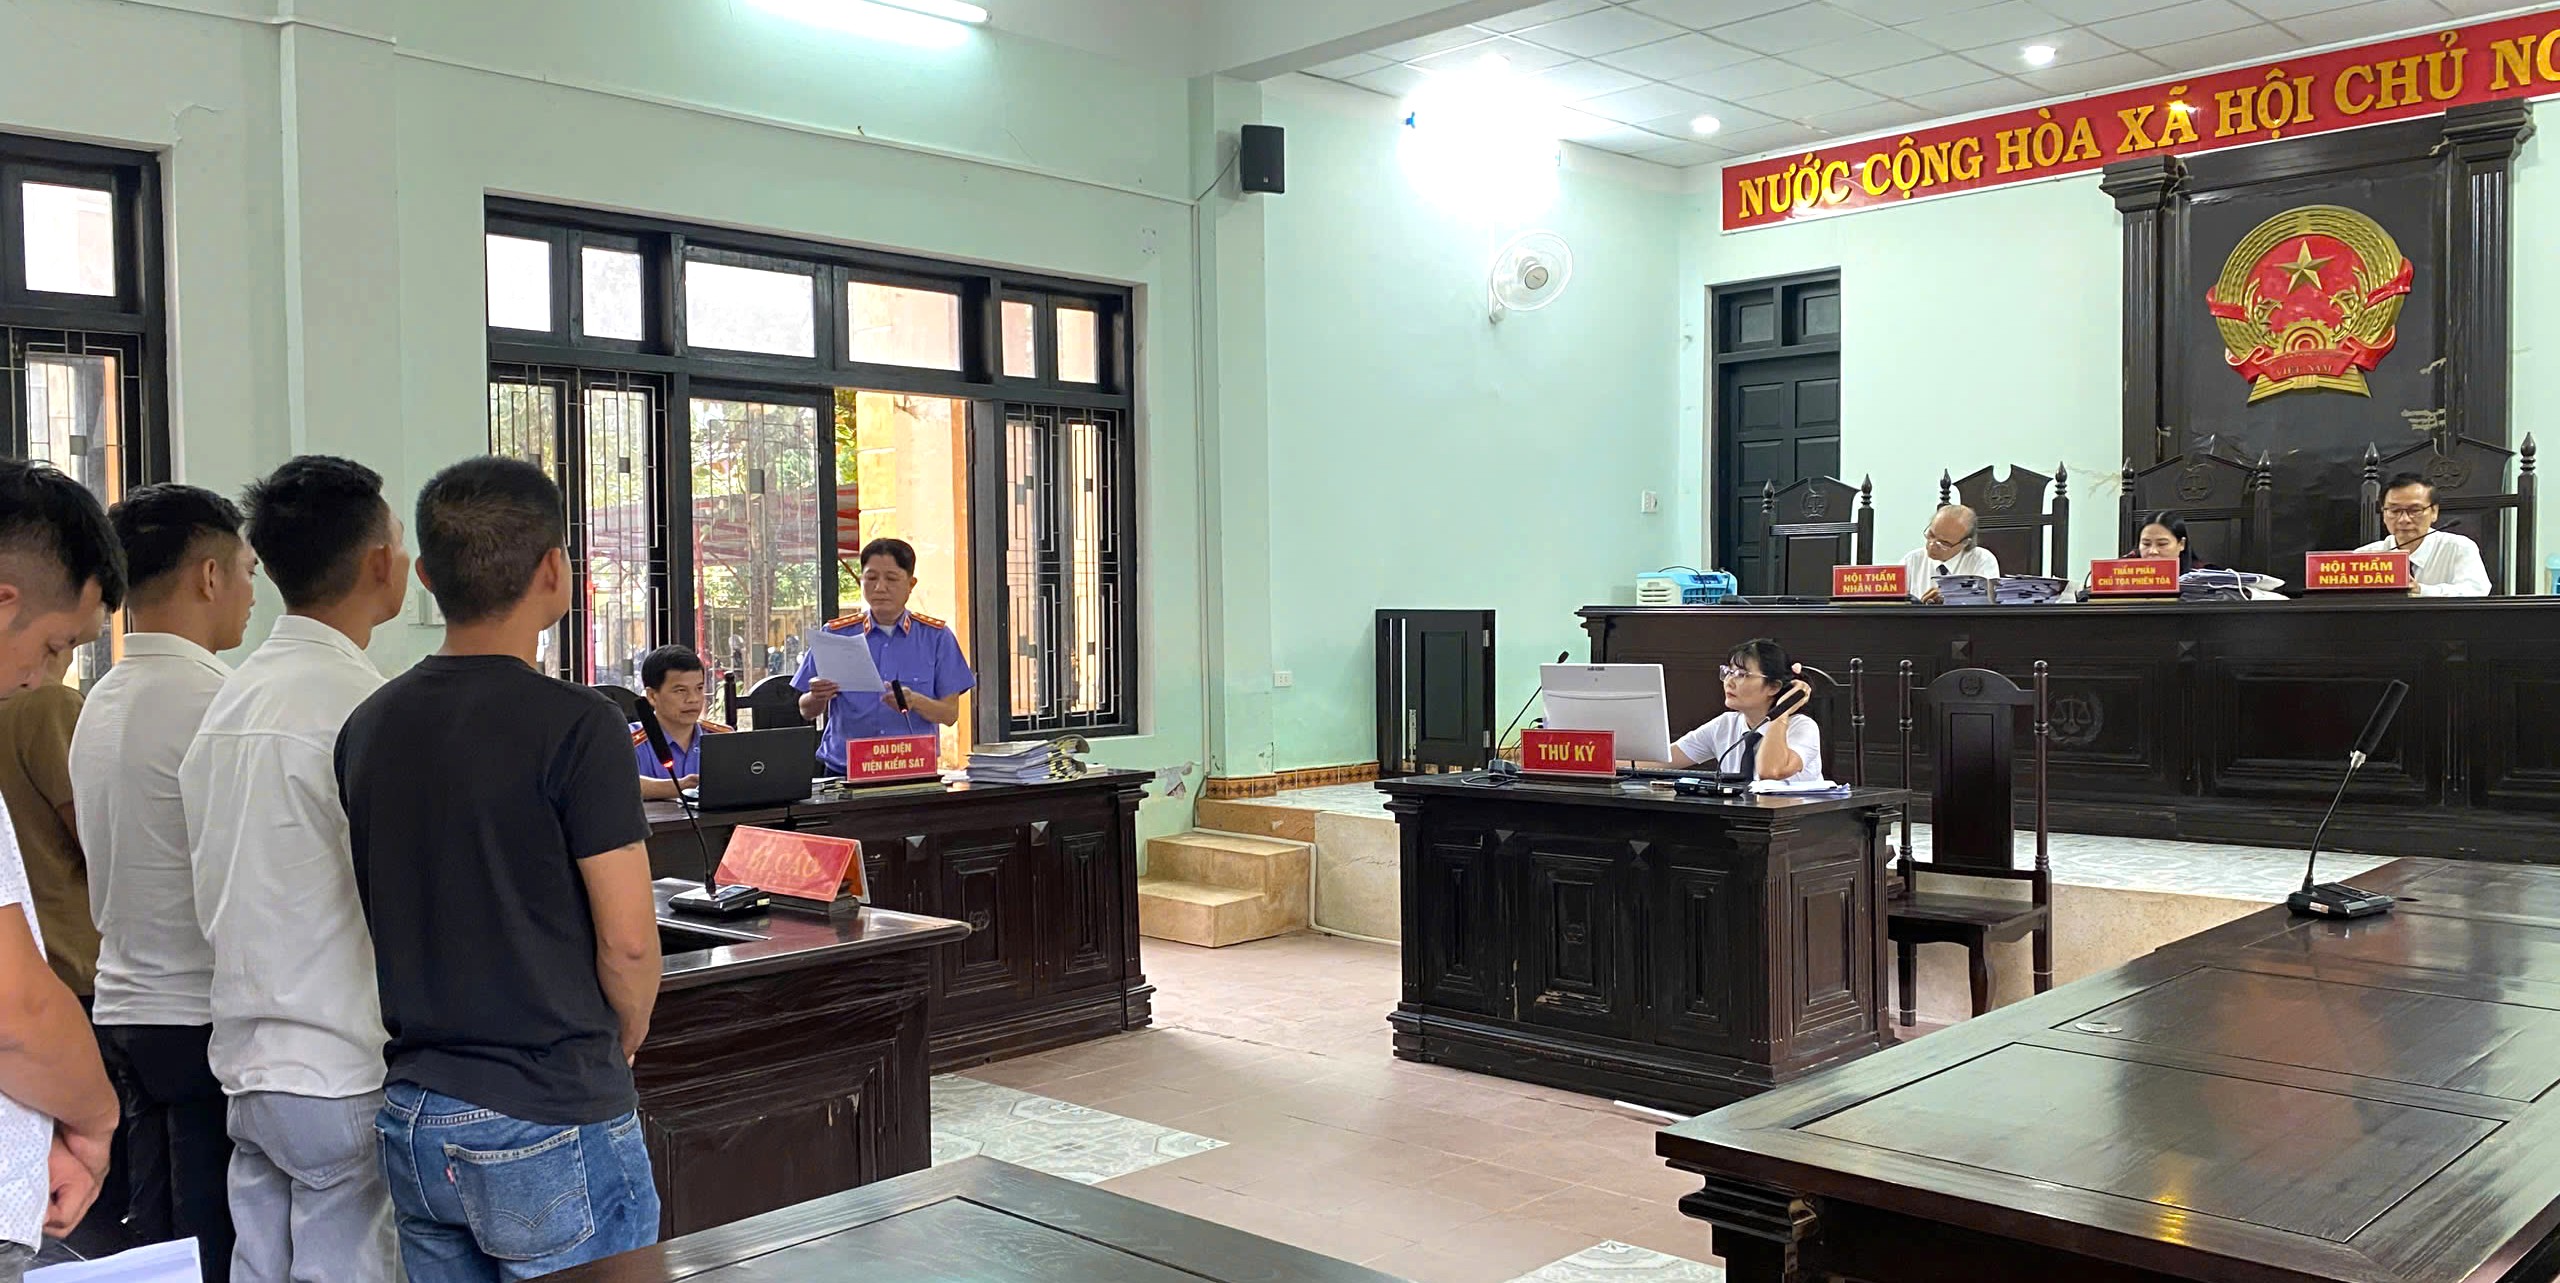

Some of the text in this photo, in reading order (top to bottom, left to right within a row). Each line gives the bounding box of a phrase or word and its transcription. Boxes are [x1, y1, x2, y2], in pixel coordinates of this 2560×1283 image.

[1738, 152, 1850, 219] NƯỚC
[1861, 135, 1984, 199] CỘNG
[1995, 107, 2102, 175] HÒA
[2116, 85, 2199, 154] XÃ
[2214, 68, 2315, 139] HỘI
[2333, 30, 2469, 116] CHỦ
[2320, 557, 2393, 573] HỘI THẨM
[1843, 569, 1896, 583] HỘI THẨM
[2319, 572, 2395, 585] NHÂN DÂN
[1842, 581, 1897, 593] NHÂN DÂN
[873, 741, 912, 757] ĐẠI DIỆN
[1538, 740, 1596, 762] THƯ KÝ
[861, 759, 882, 774] VIỆN
[884, 755, 906, 771] KIỂM
